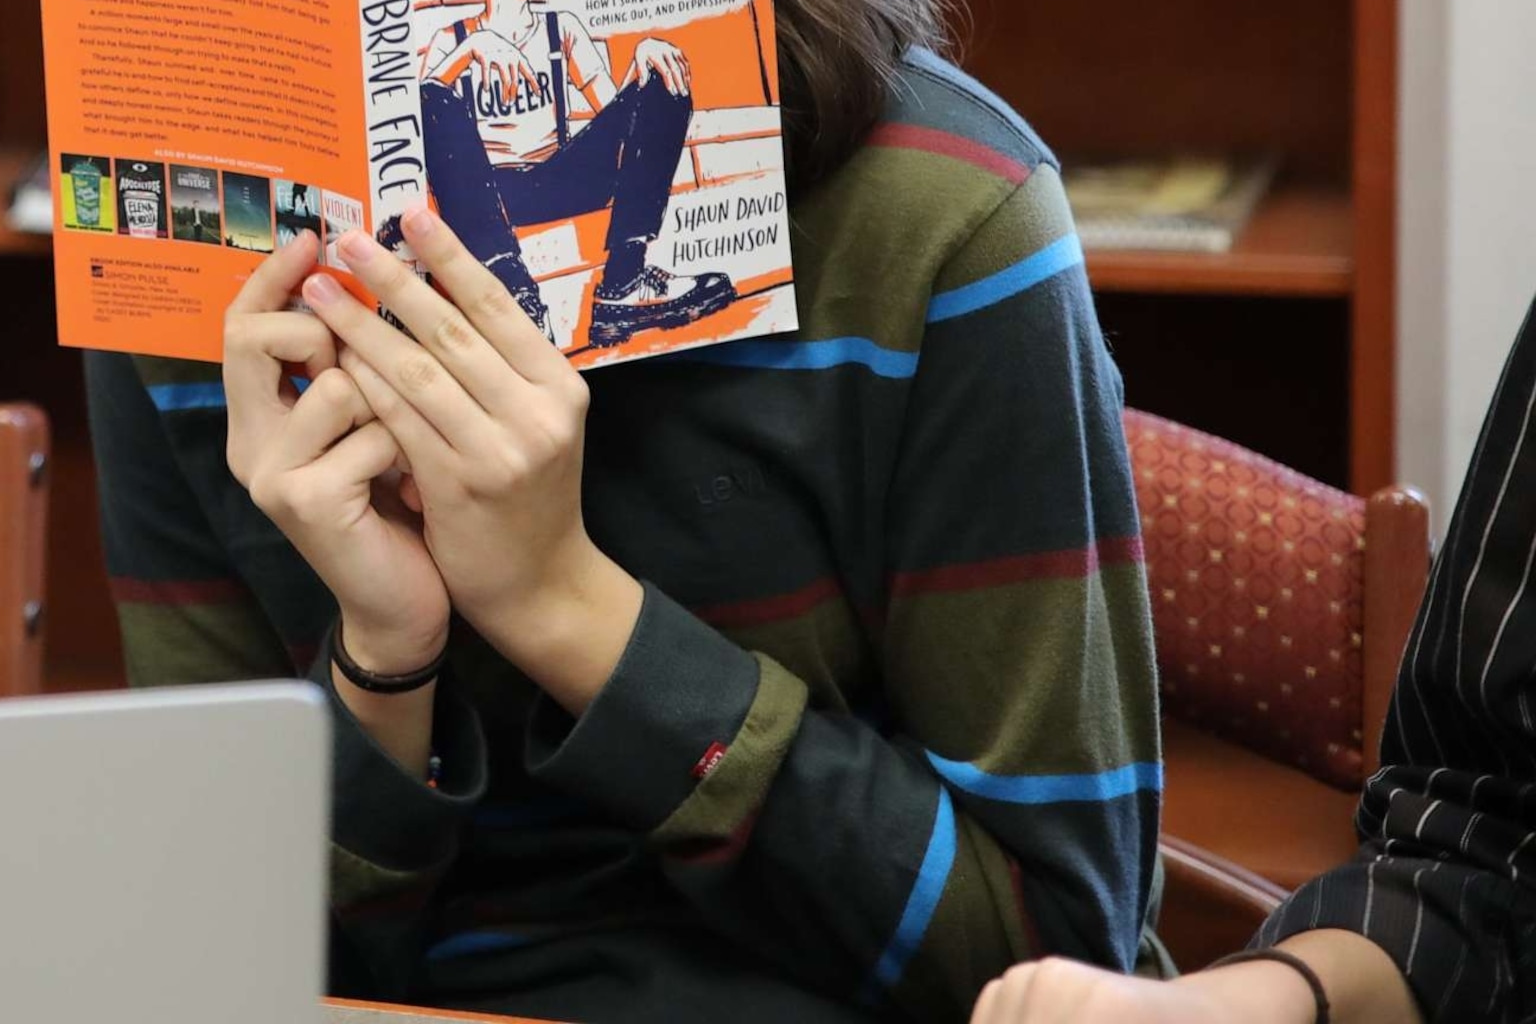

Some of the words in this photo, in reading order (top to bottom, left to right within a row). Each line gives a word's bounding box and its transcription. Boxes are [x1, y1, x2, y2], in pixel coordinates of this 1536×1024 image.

[589, 10, 626, 27] COMING
[630, 6, 651, 22] OUT,
[655, 3, 674, 16] AND
[477, 71, 553, 118] QUEER
[369, 115, 423, 199] FACE
[119, 177, 161, 194] APOCALYPSE
[177, 177, 211, 190] UNIVERSE
[324, 197, 361, 227] VIOLENT
[673, 199, 729, 233] SHAUN
[736, 190, 784, 224] DAVID
[673, 223, 778, 267] HUTCHINSON
